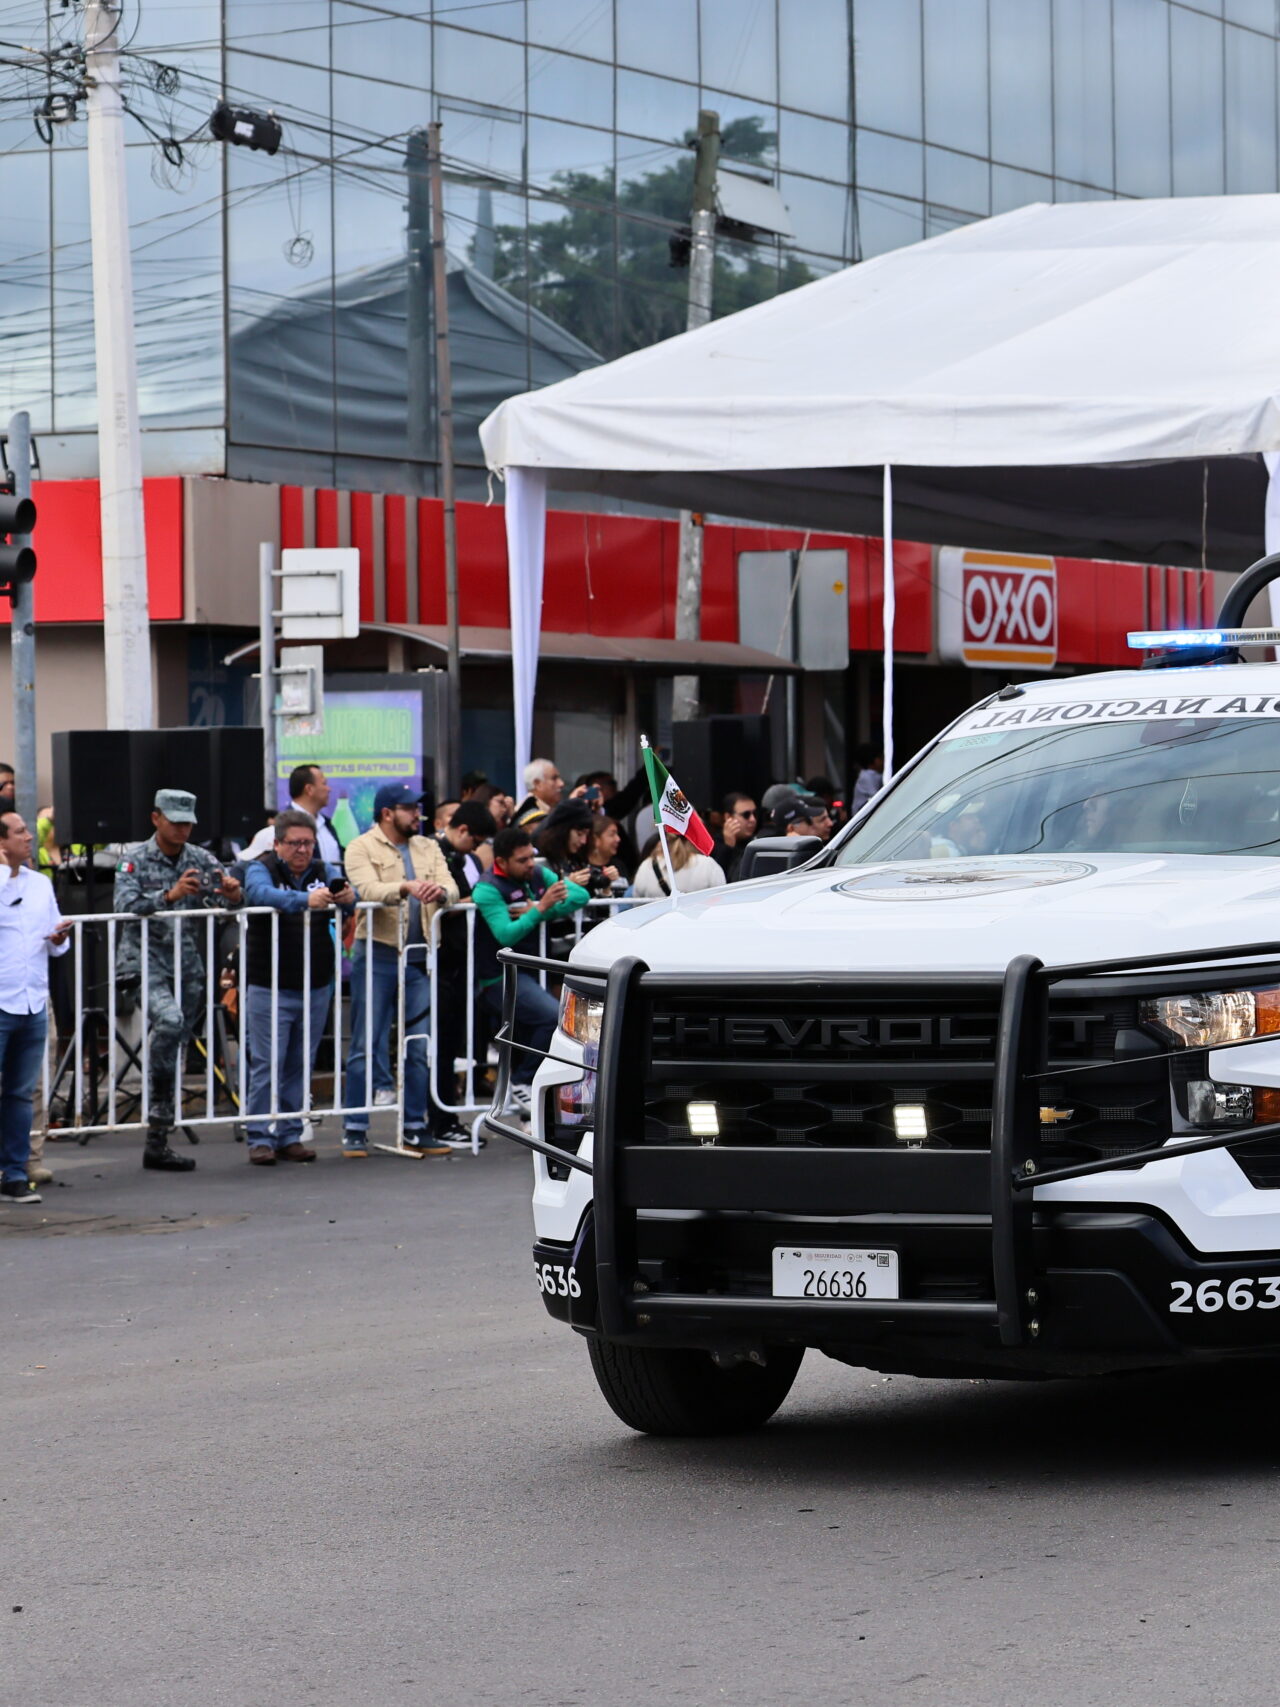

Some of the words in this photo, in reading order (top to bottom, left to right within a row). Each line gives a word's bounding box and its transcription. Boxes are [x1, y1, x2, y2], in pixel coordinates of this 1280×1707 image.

[965, 574, 1052, 643] OXXO
[653, 1015, 1105, 1047] HEVROLT
[803, 1270, 867, 1297] 26636
